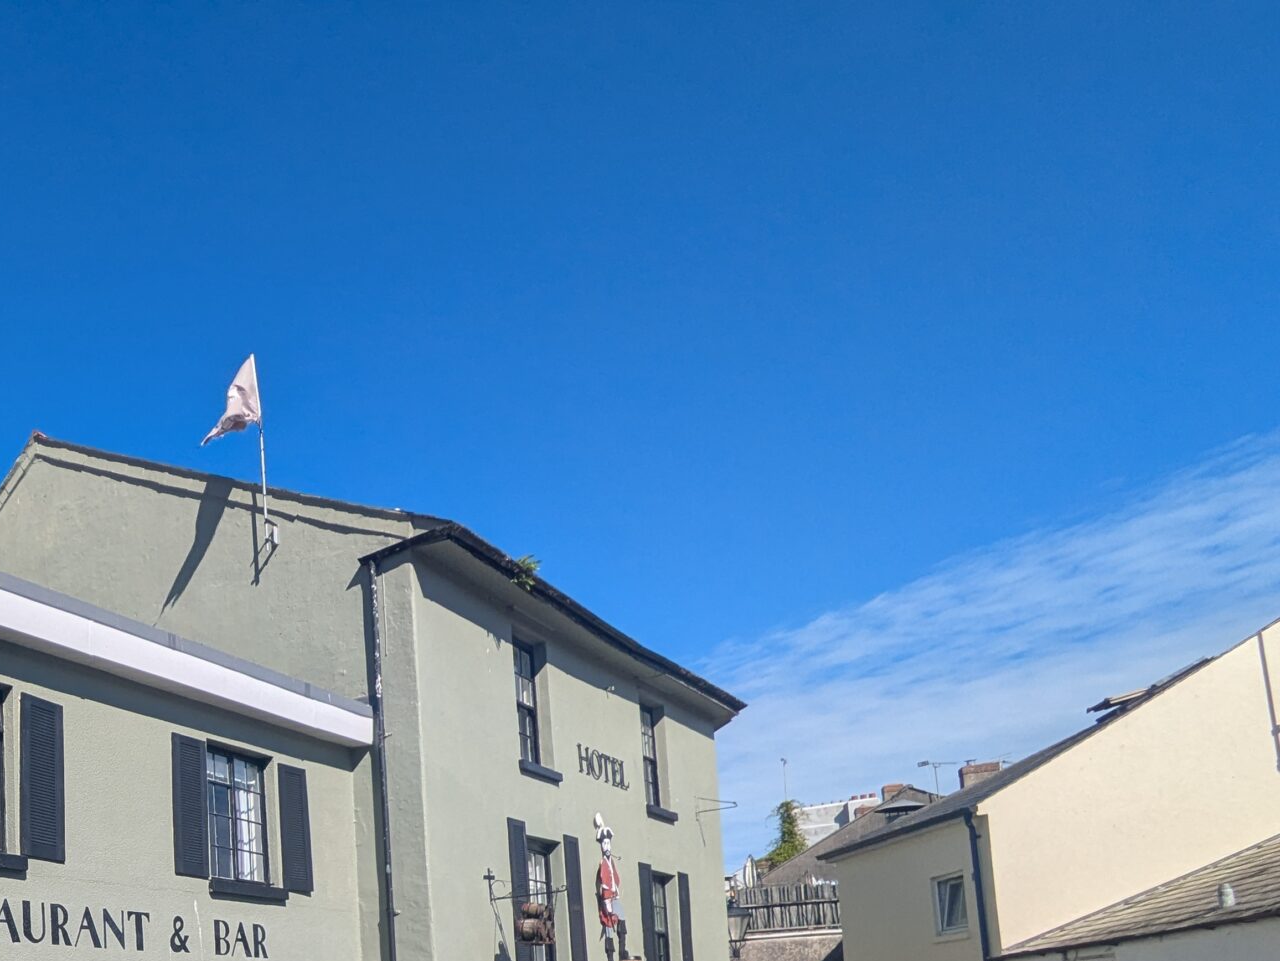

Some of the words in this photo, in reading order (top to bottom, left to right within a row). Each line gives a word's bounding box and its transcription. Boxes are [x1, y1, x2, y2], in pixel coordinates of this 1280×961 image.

[576, 743, 630, 791] HOTEL
[169, 914, 191, 954] &
[213, 918, 269, 959] BAR
